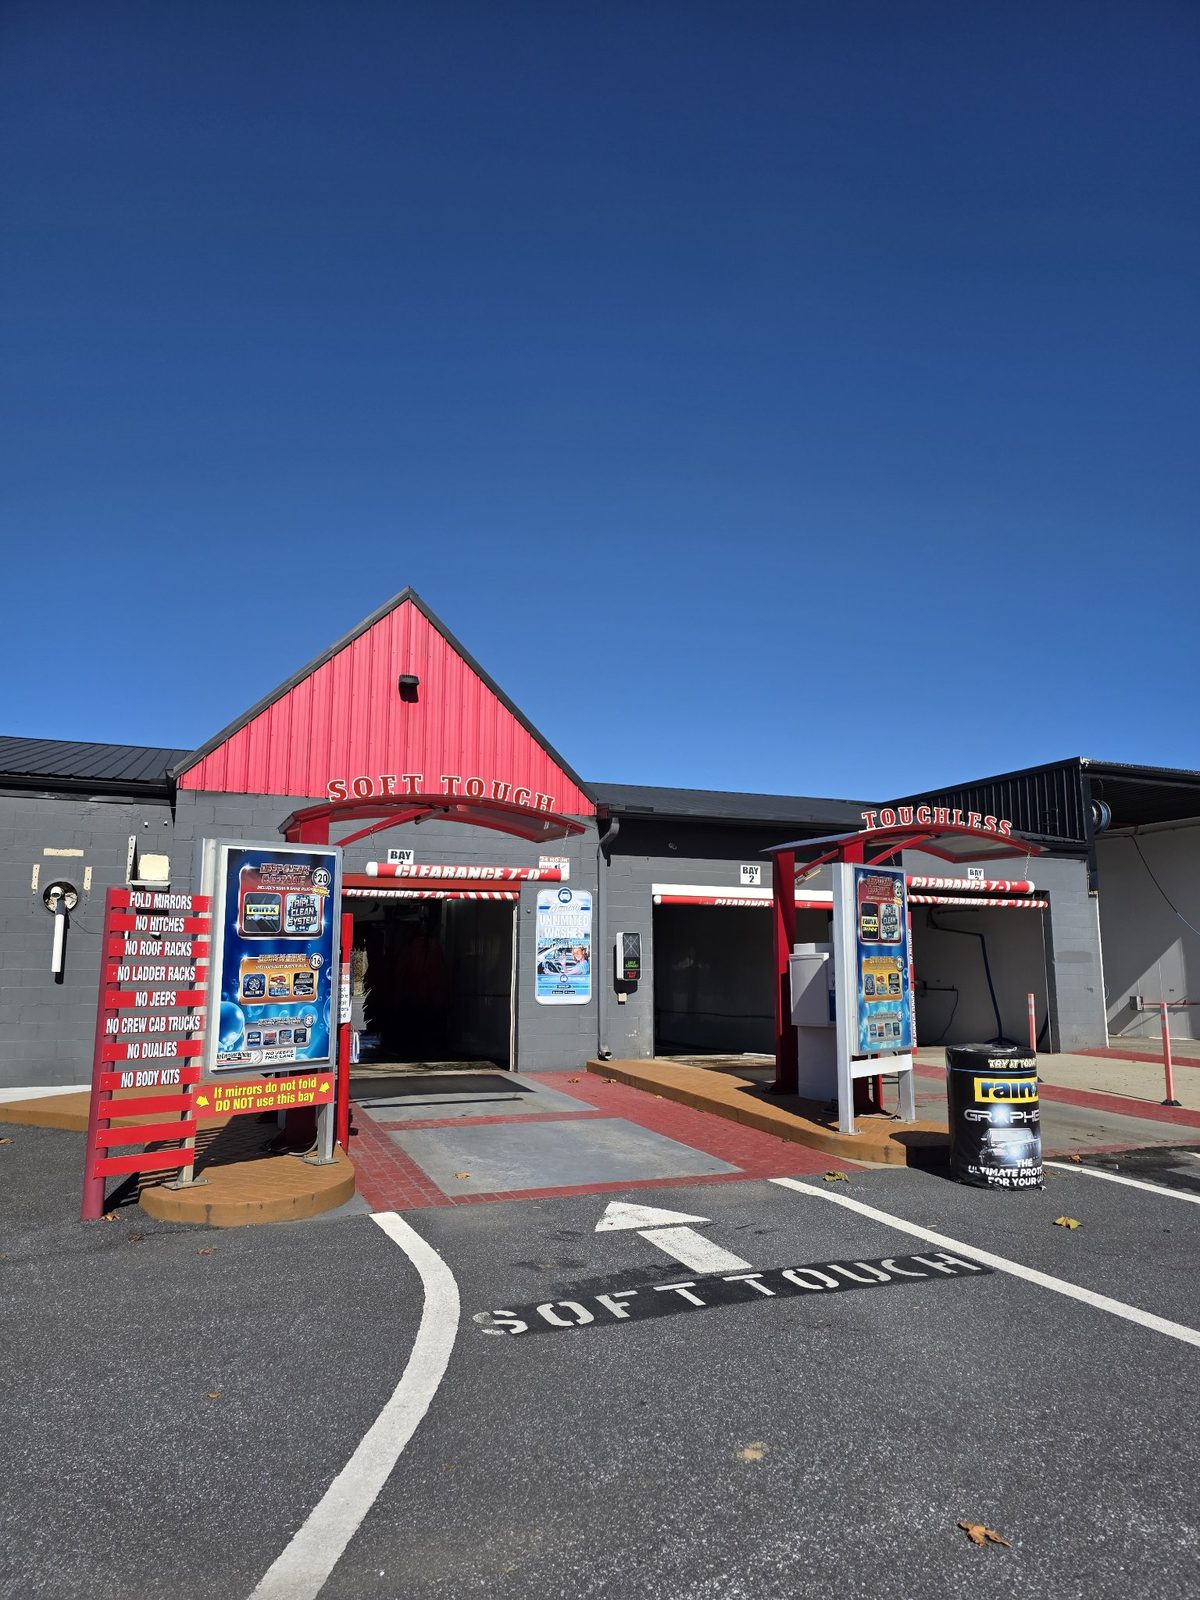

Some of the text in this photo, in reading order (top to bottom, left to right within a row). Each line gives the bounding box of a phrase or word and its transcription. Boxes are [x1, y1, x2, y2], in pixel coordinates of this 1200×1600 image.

[327, 774, 556, 812] SOFT TOUCH
[861, 806, 1012, 836] TOUCHLESS
[390, 850, 412, 860] BAY
[394, 864, 504, 880] CLEARANCE
[742, 866, 759, 875] BAY
[314, 873, 328, 884] $20
[749, 875, 755, 883] 2
[911, 876, 986, 890] CLEARANCE
[347, 889, 420, 898] CLEARANCE
[130, 892, 192, 910] FOLD MIRRORS
[290, 897, 315, 908] TRIPLE
[291, 908, 314, 916] CLEAN
[136, 916, 184, 932] NO HITCHES
[288, 917, 317, 926] SYSTEM
[540, 914, 589, 926] UNLIMITED
[544, 926, 584, 938] WASHES
[125, 941, 192, 956] NO ROOF RACKS
[117, 966, 196, 981] NO LADDER RACKS
[136, 991, 176, 1007] NO JEEPS
[106, 1015, 200, 1034] NO CREW CAB TRUCKS
[127, 1041, 177, 1059] NO DUALIES
[988, 1059, 1009, 1068] TRY
[1009, 1059, 1018, 1068] IT
[121, 1069, 180, 1088] NO BODY KITS
[214, 1078, 317, 1098] If mirrors do not fold
[216, 1091, 314, 1112] DO NOT use this bay
[1016, 1158, 1033, 1167] THE
[968, 1165, 1018, 1177] ULTIMATE
[1012, 1178, 1036, 1186] YOUR
[472, 1252, 982, 1336] SOFT TOUCH
